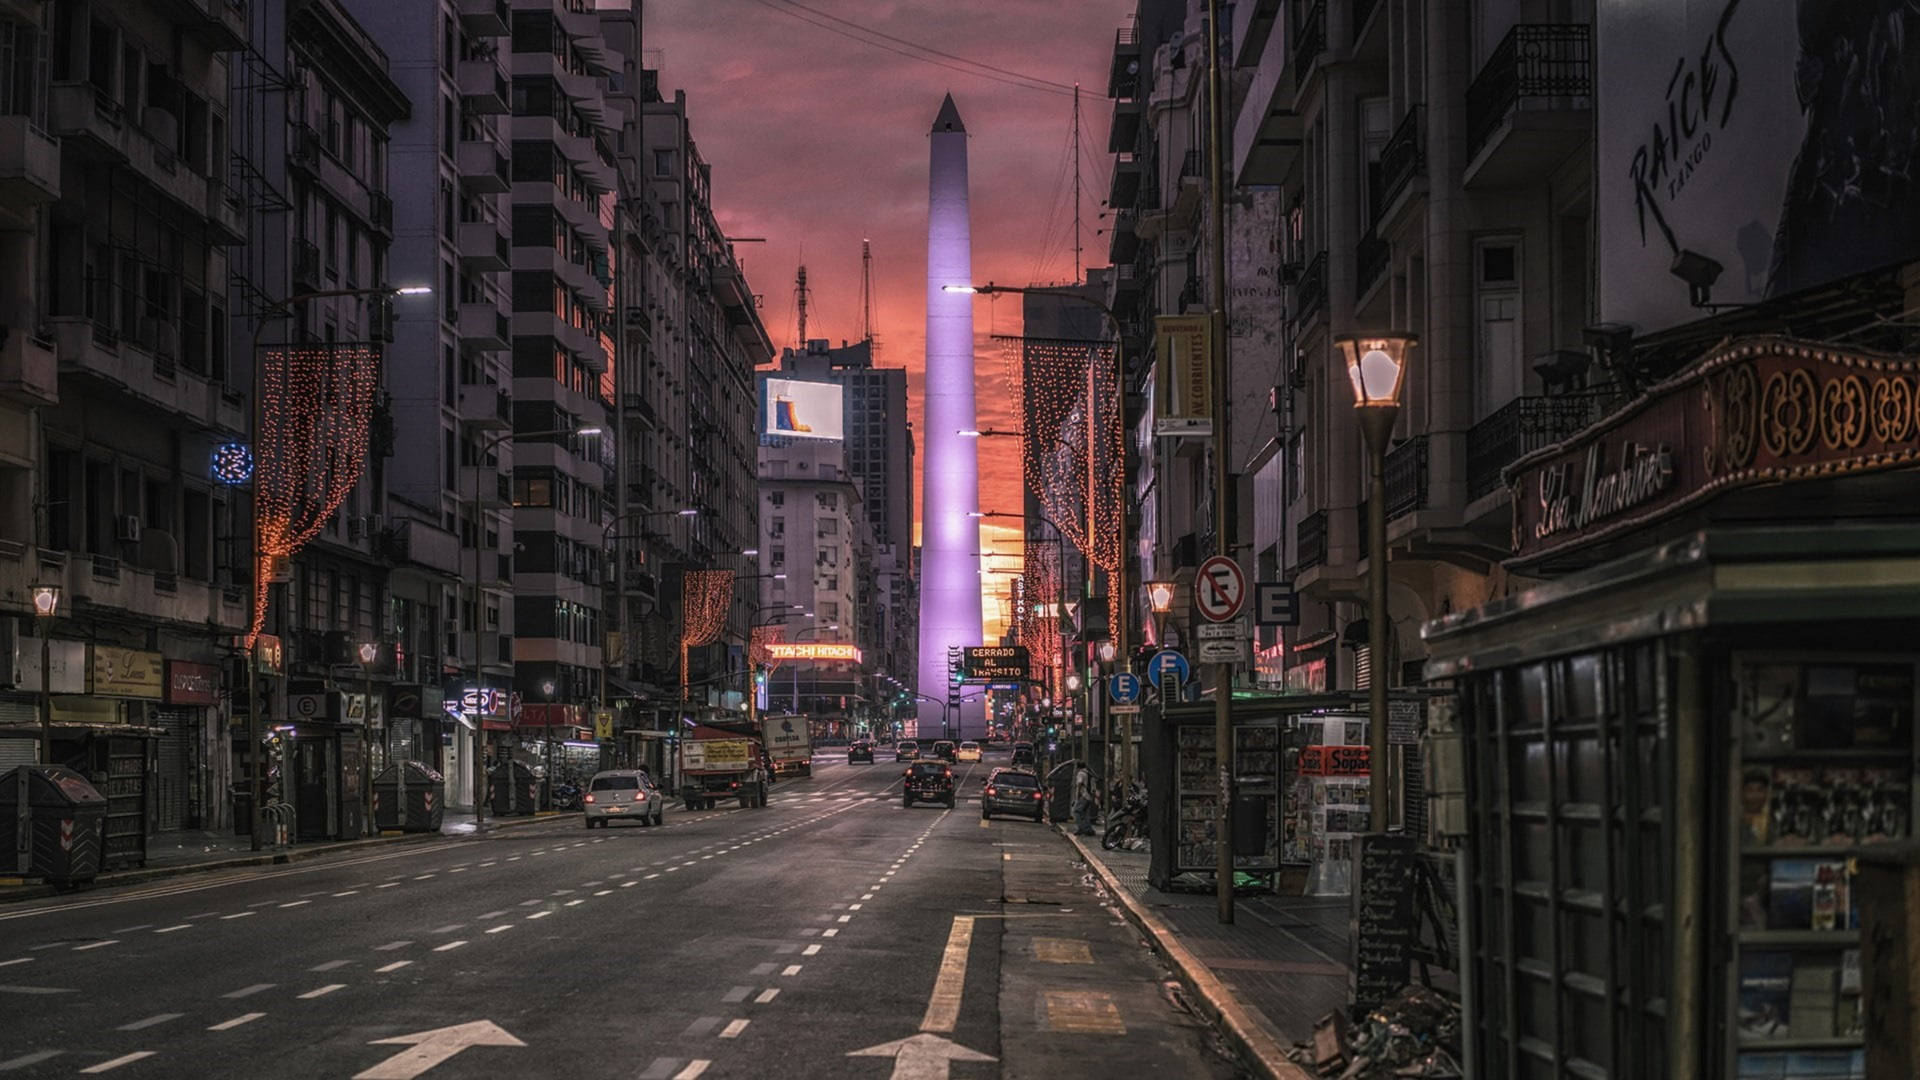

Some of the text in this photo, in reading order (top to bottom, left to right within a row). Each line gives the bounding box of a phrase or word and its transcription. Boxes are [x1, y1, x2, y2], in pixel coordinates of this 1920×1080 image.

[1629, 0, 1741, 252] RAÍCES
[1667, 131, 1713, 202] TANGO
[1192, 334, 1204, 399] CORRIENTES
[1210, 571, 1231, 607] E
[1261, 585, 1294, 623] E
[818, 647, 852, 656] HITACHI
[972, 648, 1015, 657] CERRADO
[984, 658, 997, 667] AL
[1118, 675, 1131, 693] E
[303, 700, 311, 711] E
